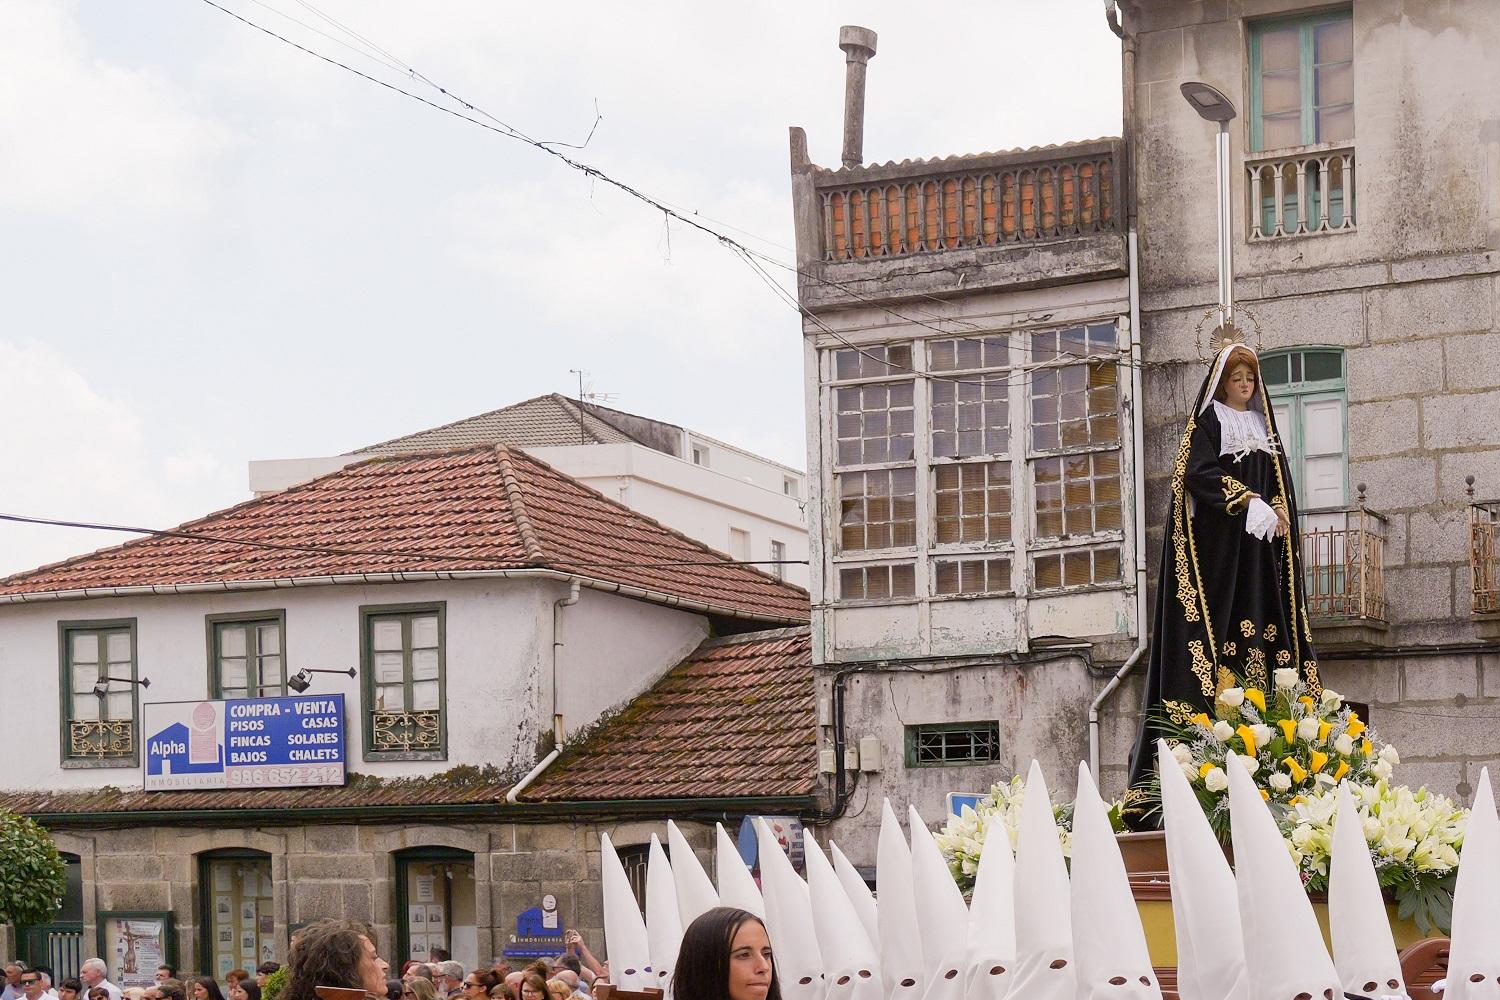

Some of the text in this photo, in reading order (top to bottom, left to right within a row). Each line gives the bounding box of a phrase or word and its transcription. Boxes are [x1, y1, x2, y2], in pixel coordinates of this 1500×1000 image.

[230, 704, 281, 718] COMPRA
[295, 701, 336, 715] VENTA
[230, 717, 338, 732] PISOS CASAS
[230, 733, 338, 747] FINCAS SOLARES
[151, 741, 186, 758] Alpha
[231, 749, 339, 763] BAJOS CHALETS
[146, 777, 225, 787] INMOBILIARIA
[231, 770, 266, 785] 986
[268, 768, 301, 784] 652
